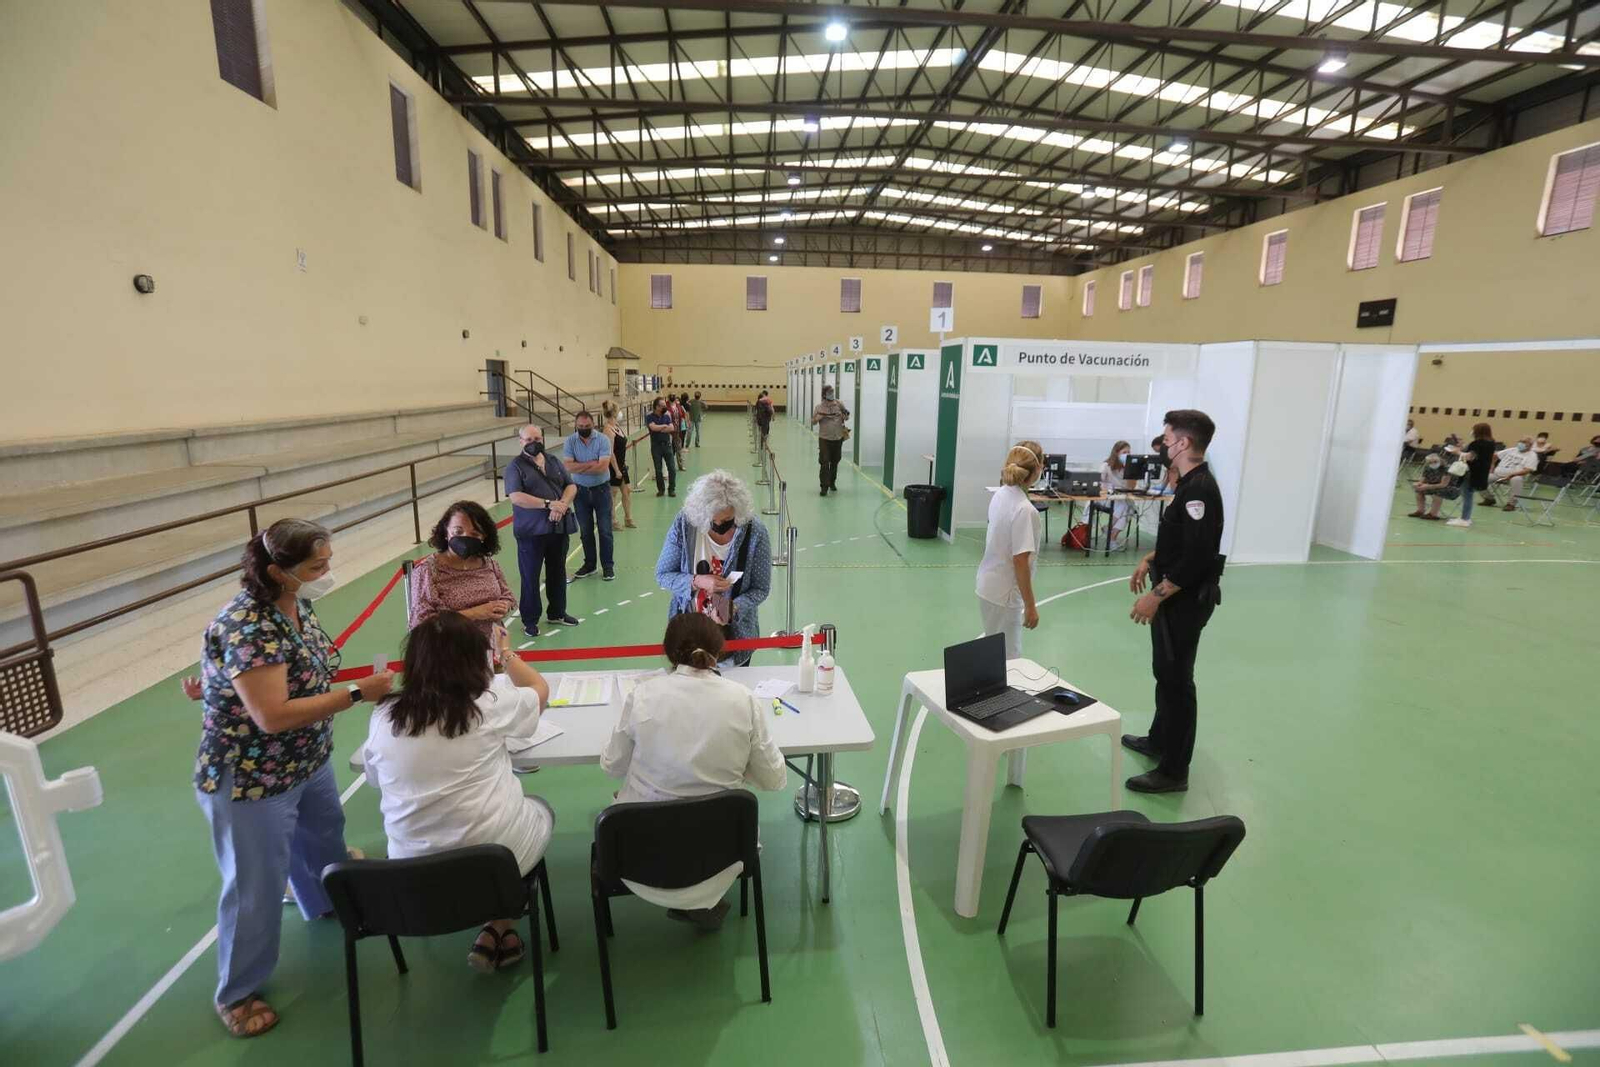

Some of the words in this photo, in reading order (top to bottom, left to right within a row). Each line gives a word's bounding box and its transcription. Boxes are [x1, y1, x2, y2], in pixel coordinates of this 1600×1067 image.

[937, 312, 946, 329] 1
[884, 329, 893, 341] 2
[853, 339, 859, 349] 3
[820, 350, 825, 358] 5
[833, 346, 839, 354] 4
[1018, 352, 1057, 364] Punto
[1059, 352, 1076, 365] de
[1078, 352, 1150, 367] Vacunación
